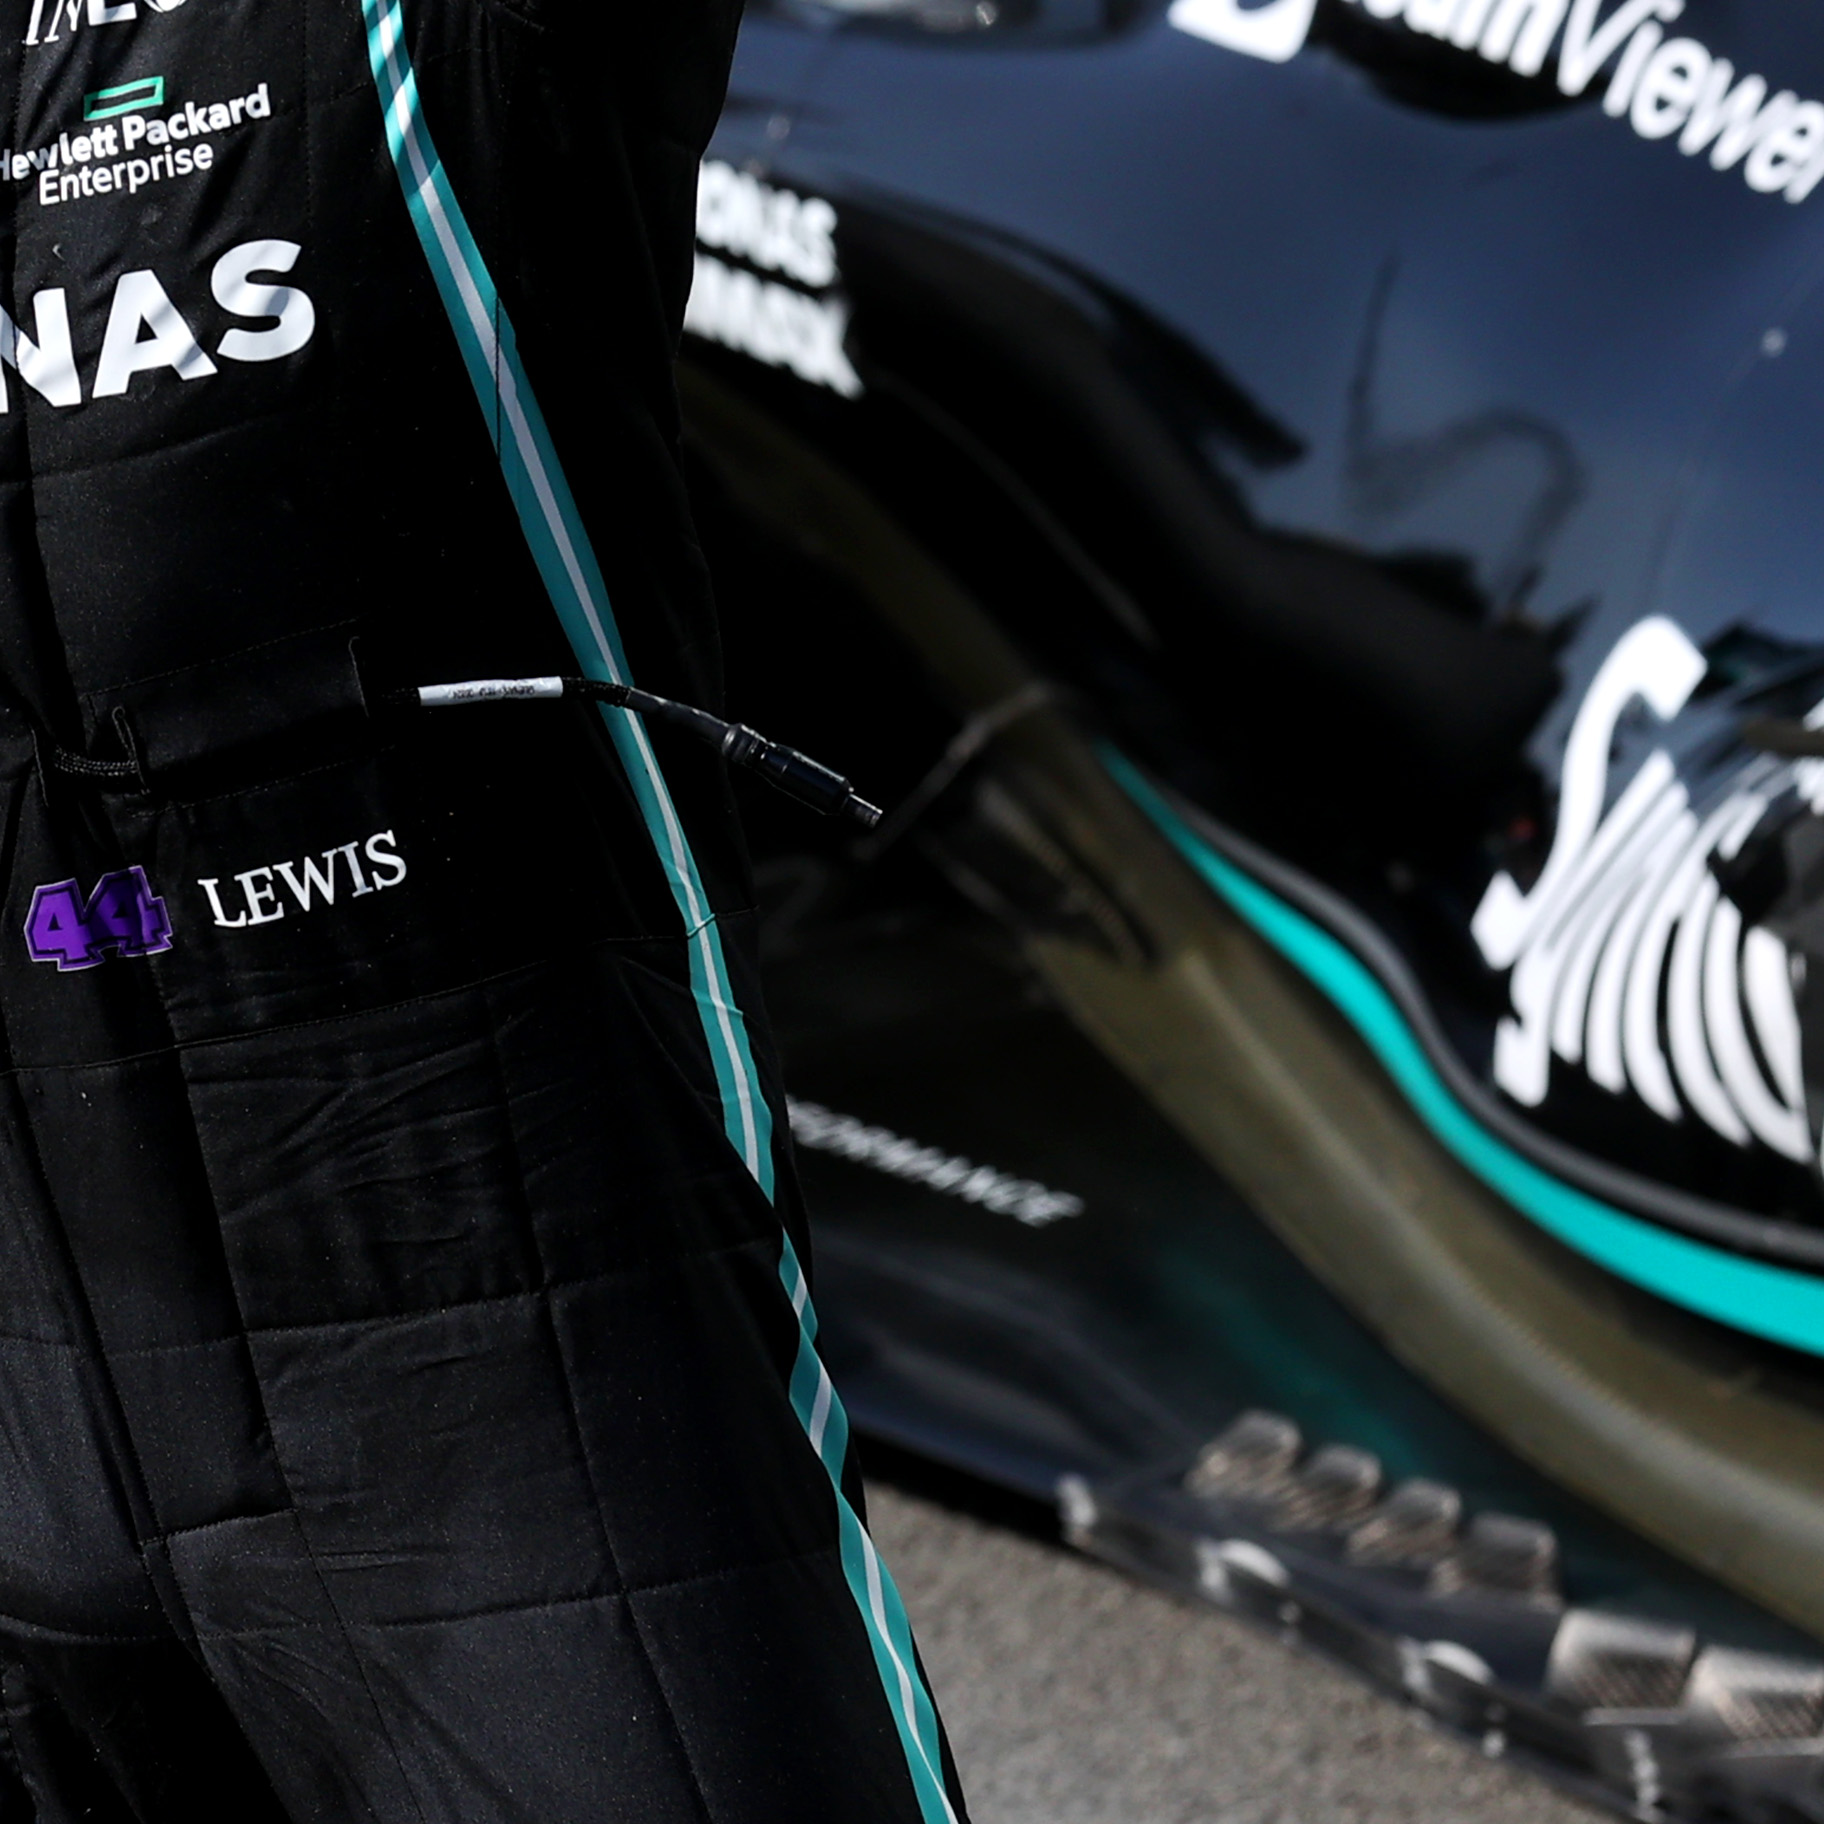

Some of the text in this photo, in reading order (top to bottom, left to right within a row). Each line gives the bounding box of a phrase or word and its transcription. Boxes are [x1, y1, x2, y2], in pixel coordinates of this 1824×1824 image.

[123, 83, 271, 150] Packard
[39, 143, 214, 206] Enterprise
[24, 828, 407, 973] 44 LEWIS
